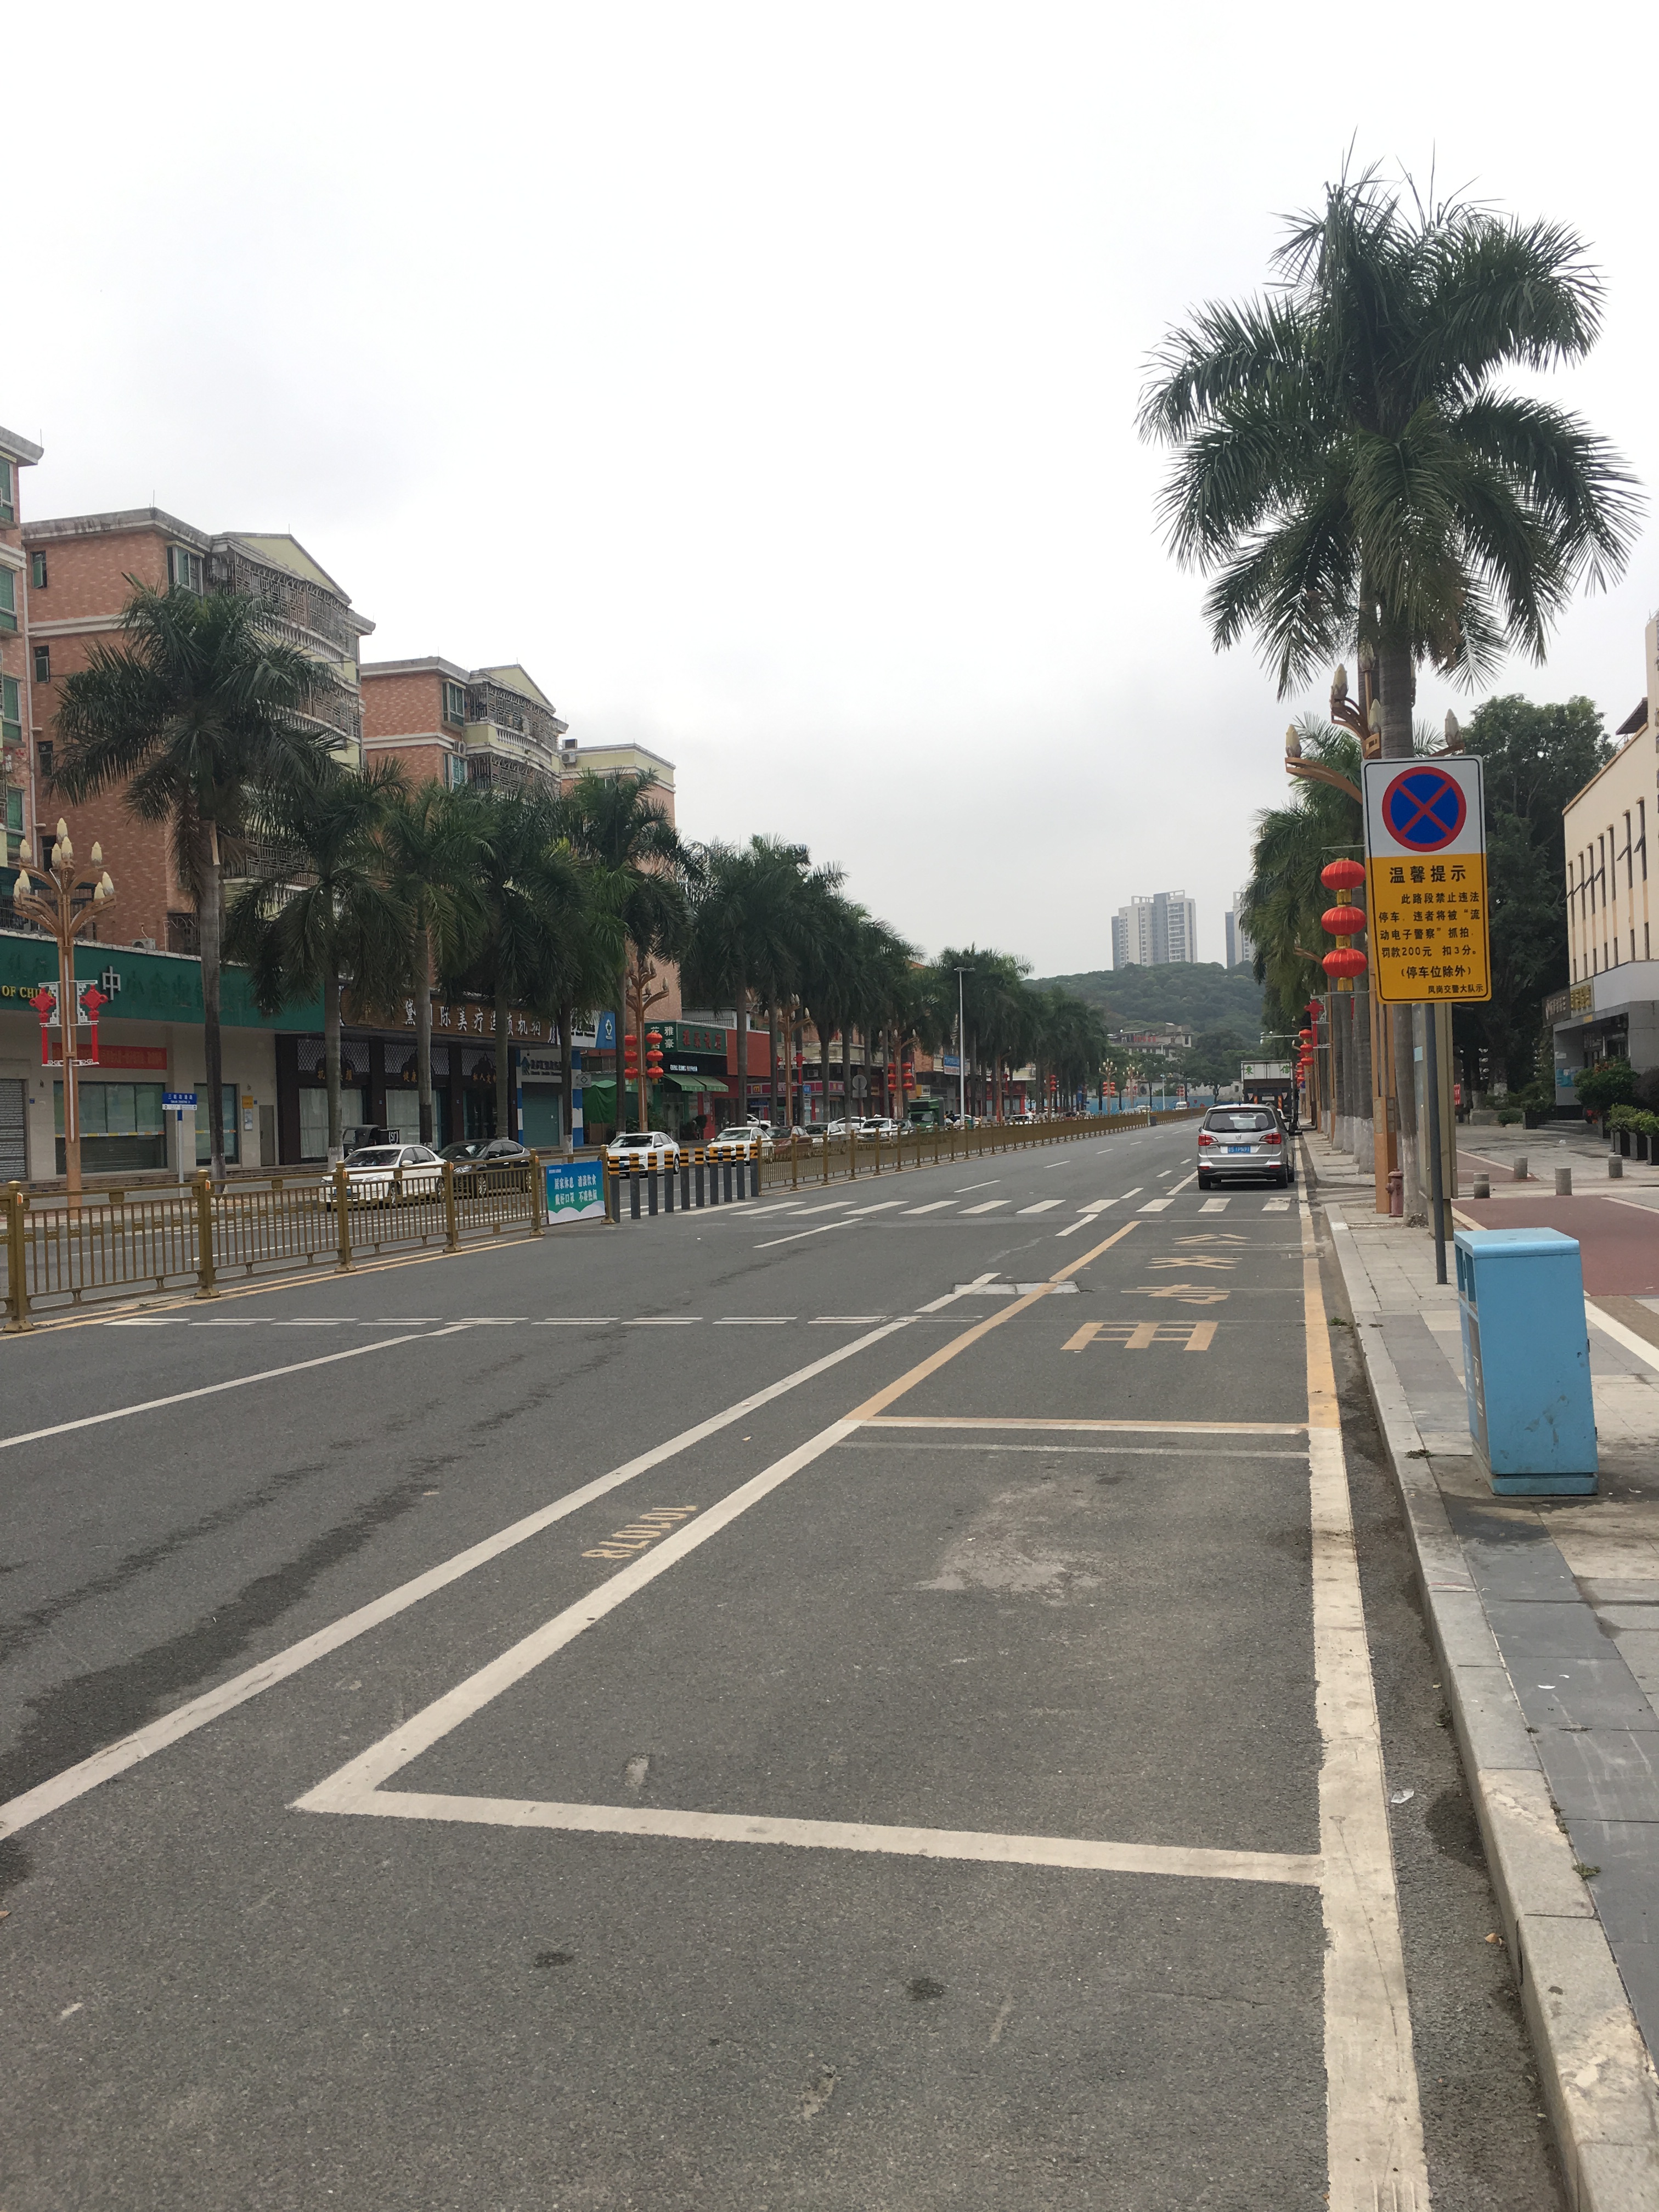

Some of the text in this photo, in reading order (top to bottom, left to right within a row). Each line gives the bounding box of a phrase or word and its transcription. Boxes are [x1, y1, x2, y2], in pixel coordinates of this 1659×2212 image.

[1389, 865, 1466, 884] 温馨提示
[1401, 891, 1480, 905] 此路段禁止违法
[2, 985, 16, 996] OF
